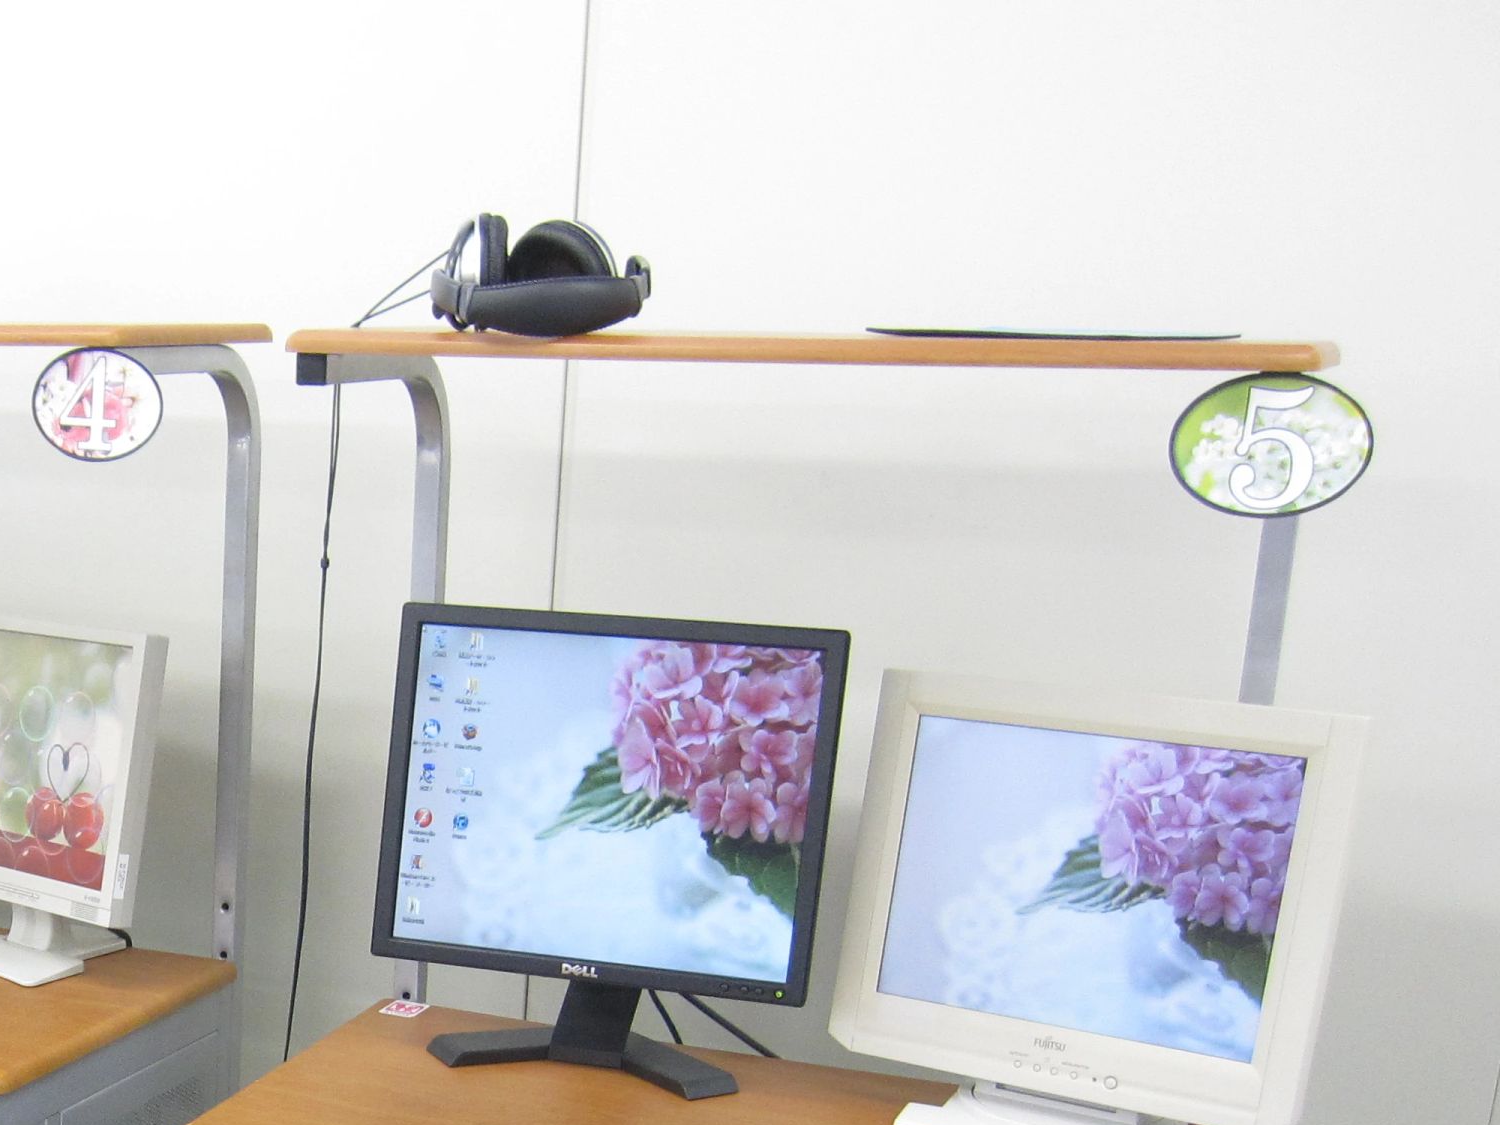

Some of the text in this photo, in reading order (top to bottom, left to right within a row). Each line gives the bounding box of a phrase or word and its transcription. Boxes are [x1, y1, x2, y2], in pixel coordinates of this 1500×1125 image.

[59, 355, 117, 452] 4
[1228, 385, 1316, 511] 5
[561, 962, 598, 978] DELL
[1033, 1036, 1067, 1052] FUJITSU
